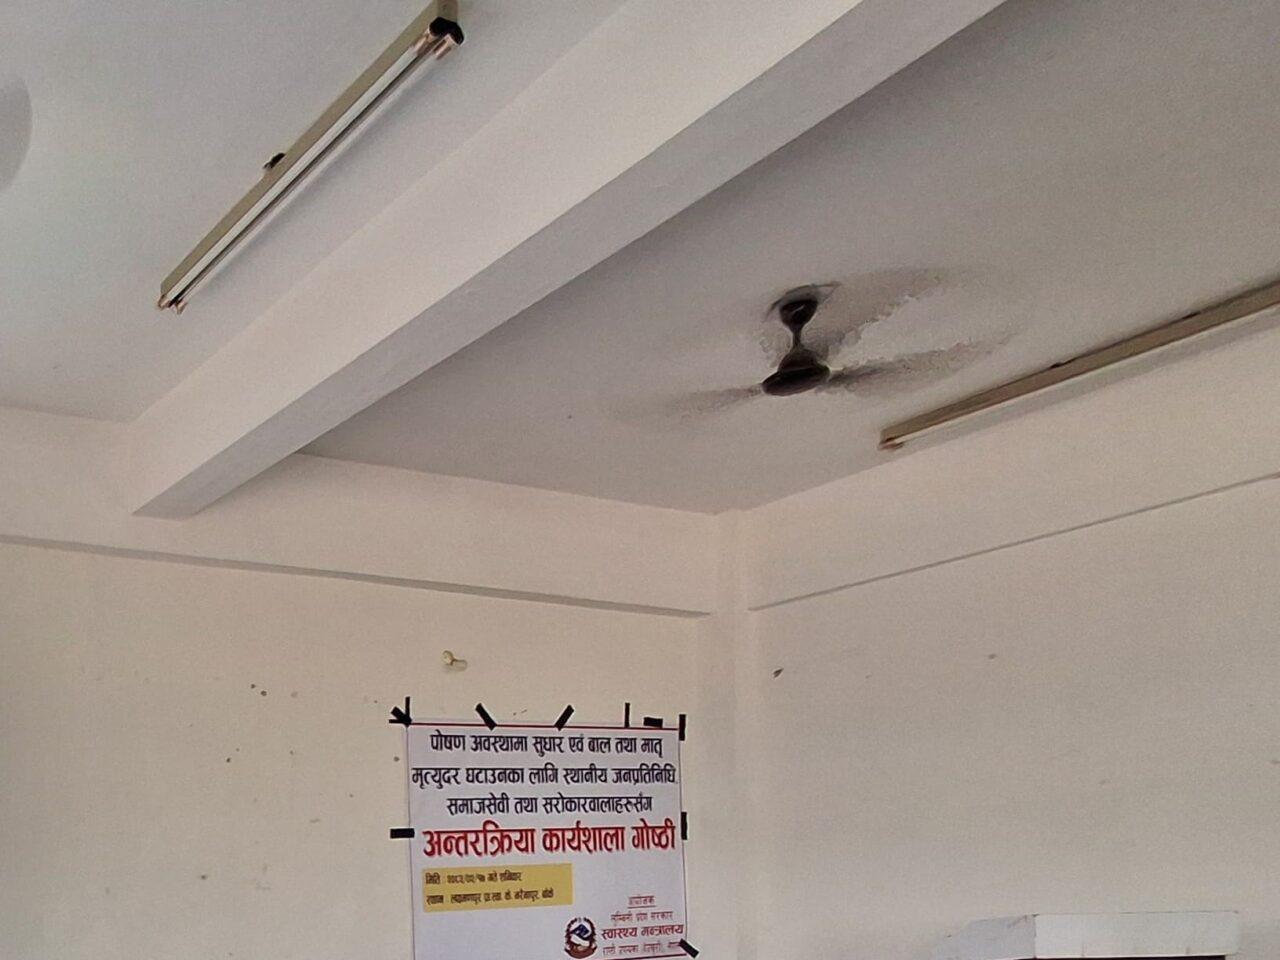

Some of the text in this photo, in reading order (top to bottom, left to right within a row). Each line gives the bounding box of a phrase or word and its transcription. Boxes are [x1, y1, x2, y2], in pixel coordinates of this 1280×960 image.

[430, 729, 663, 759] पोषण अवस्थामा सुधार एवं बाल तथा मातृ
[411, 767, 461, 789] मृत्युदर
[465, 767, 524, 784] घटाउनका
[528, 762, 559, 785] लागि
[563, 763, 608, 785] स्थानीय
[446, 792, 510, 816] समाजसेवी
[513, 797, 538, 815] तथा
[422, 817, 676, 857] अन्तरक्रिया कार्यशाला गोष्ठी
[640, 924, 684, 936] मन्त्रालय
